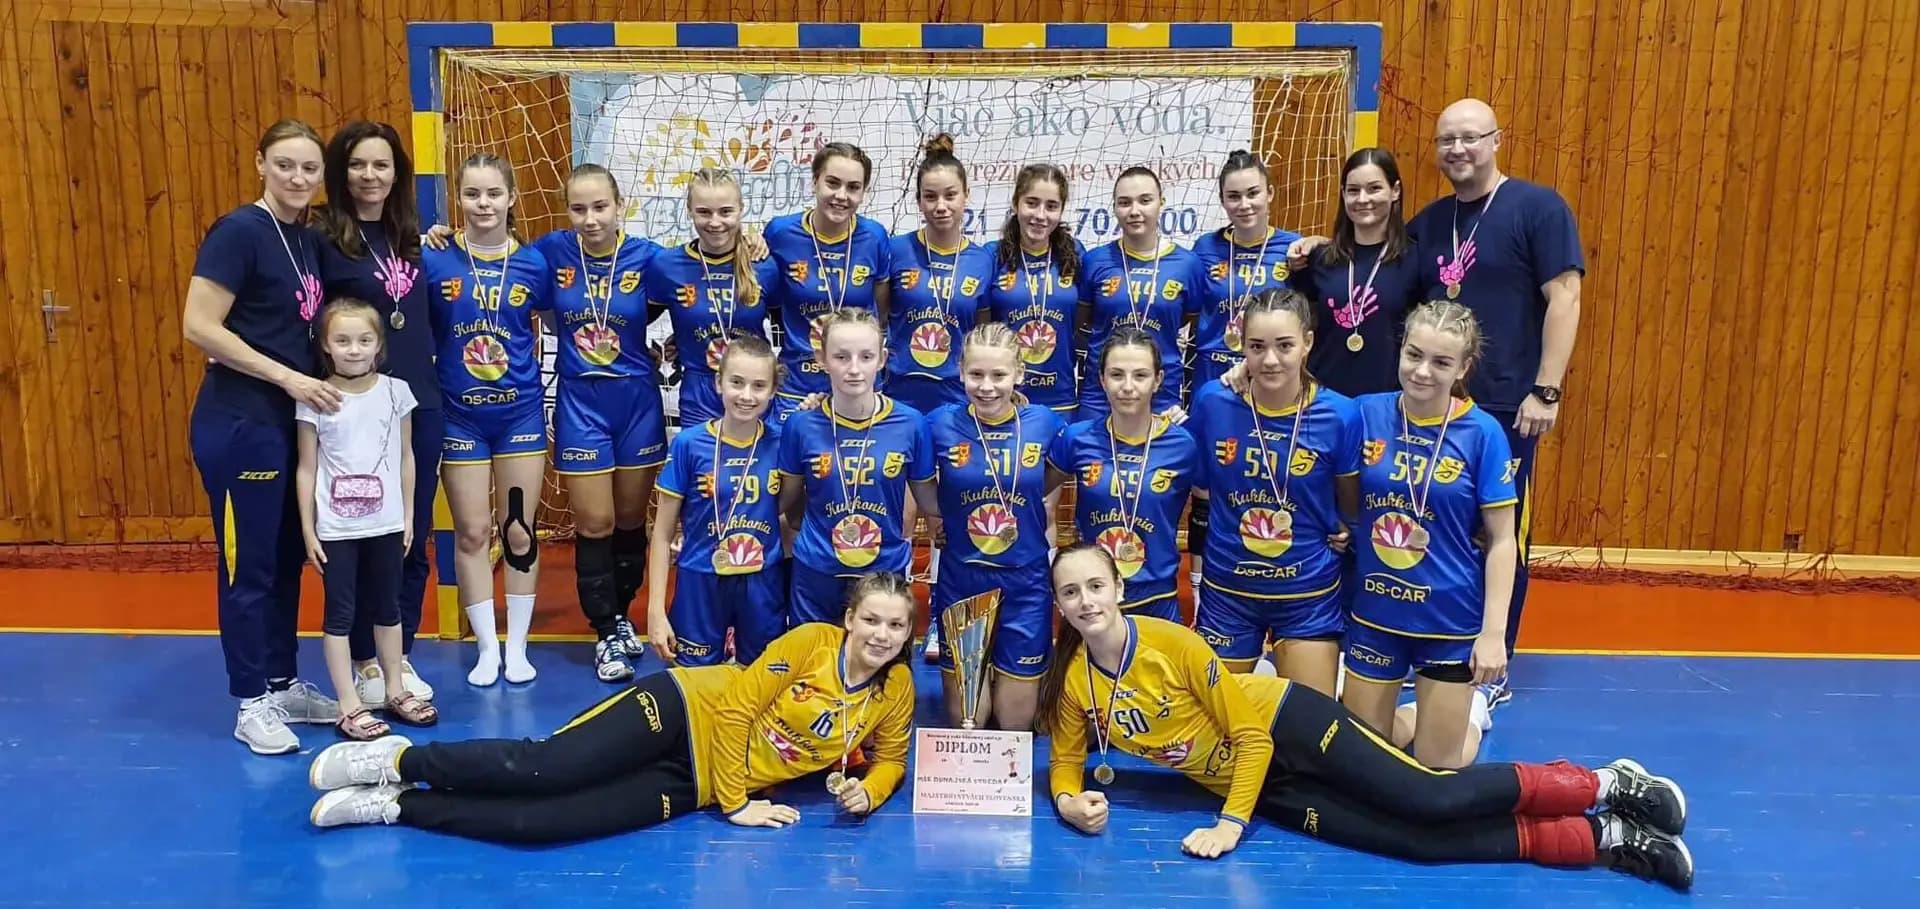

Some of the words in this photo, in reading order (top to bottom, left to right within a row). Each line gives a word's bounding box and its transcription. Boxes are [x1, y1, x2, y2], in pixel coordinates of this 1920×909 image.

[897, 92, 994, 137] Viac
[1012, 92, 1090, 136] ako
[1111, 87, 1225, 135] voda.
[818, 267, 845, 292] 57
[1238, 264, 1266, 286] 49
[462, 393, 517, 406] DS-CAR
[561, 453, 597, 461] DS-CAR
[984, 448, 1011, 476] 51
[1389, 451, 1428, 485] 53
[844, 456, 875, 486] 52
[729, 475, 760, 503] 39
[1364, 578, 1426, 603] DS-CAR
[1350, 646, 1392, 667] DS-CAR
[636, 692, 659, 731] DS-CAR
[1114, 708, 1151, 740] 50
[935, 741, 991, 754] DIPLOM
